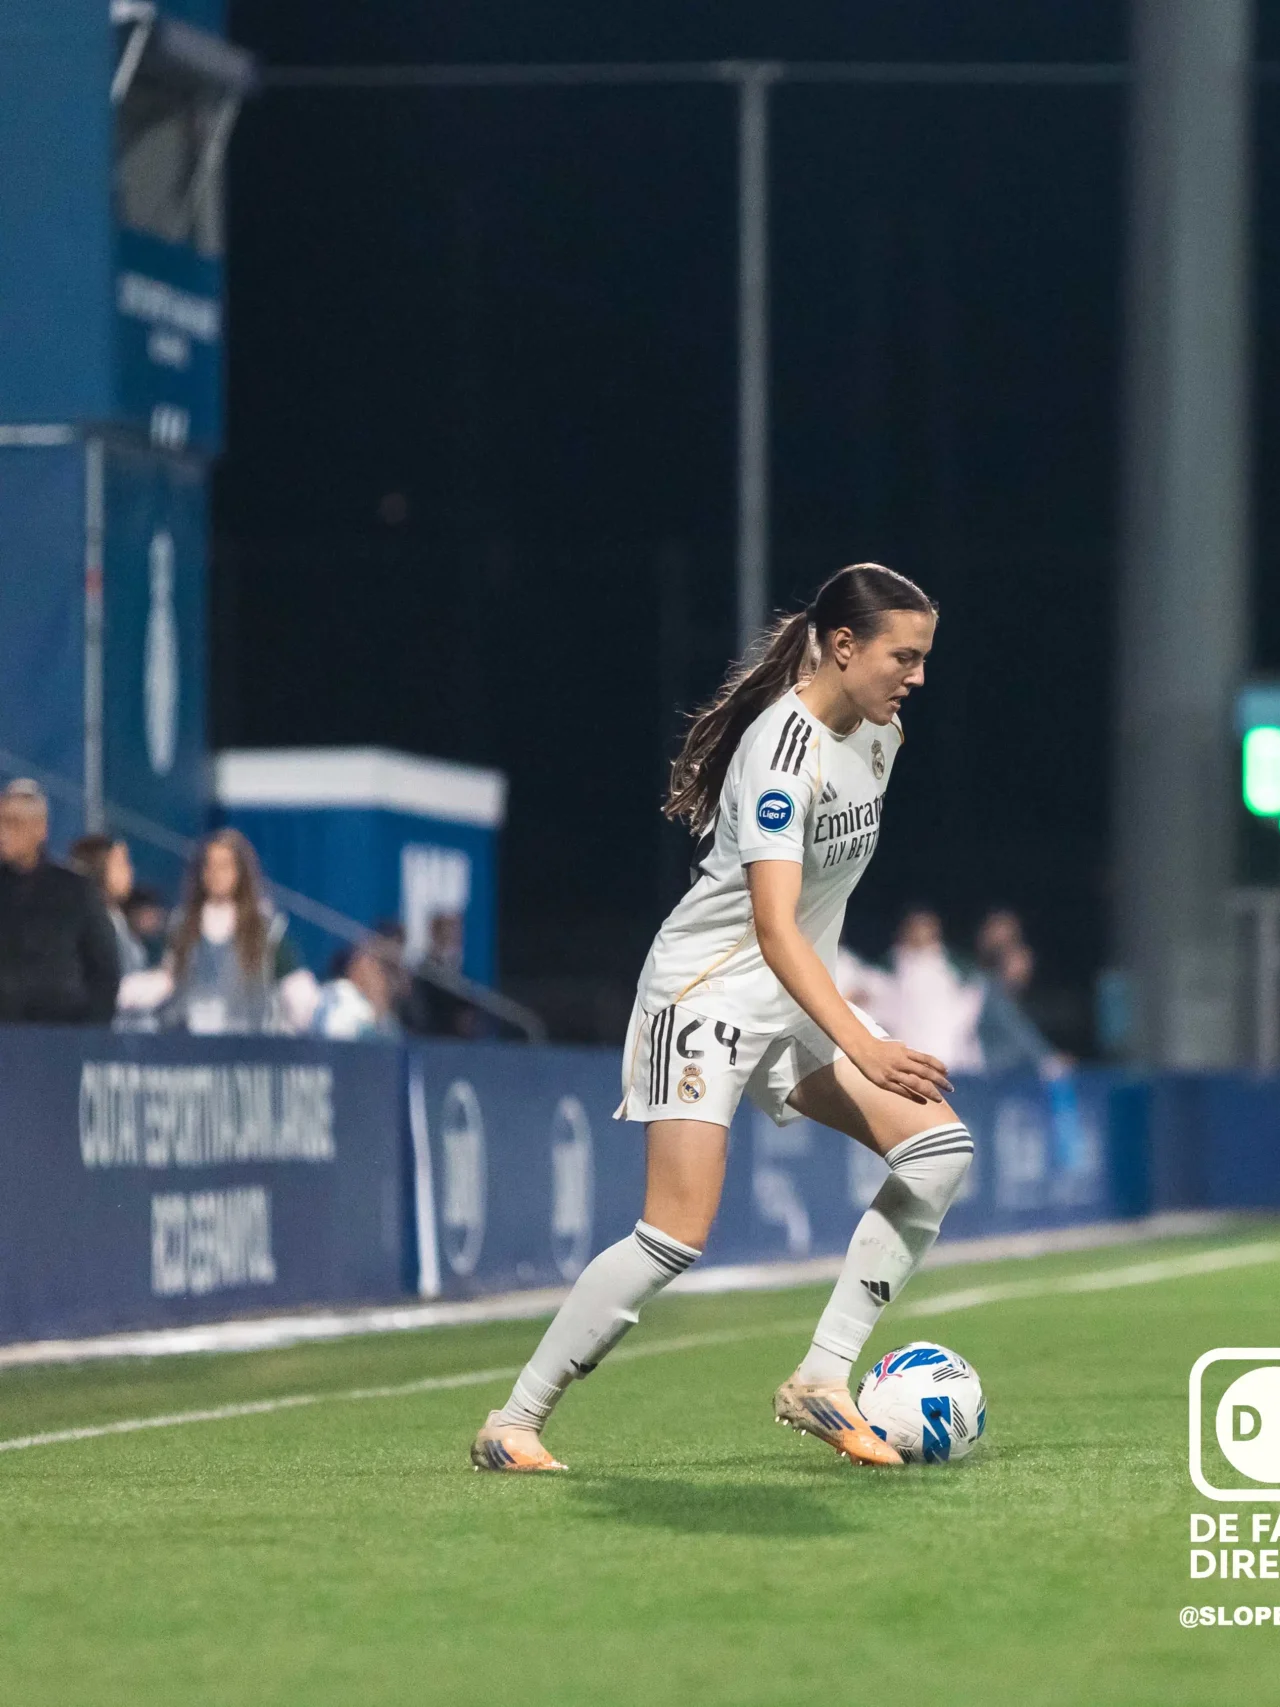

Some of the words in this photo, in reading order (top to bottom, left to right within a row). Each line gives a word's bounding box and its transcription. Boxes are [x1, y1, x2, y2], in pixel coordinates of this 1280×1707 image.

[762, 810, 780, 820] Liga
[780, 812, 787, 820] F
[822, 840, 847, 868] FLY
[846, 829, 880, 860] BETT
